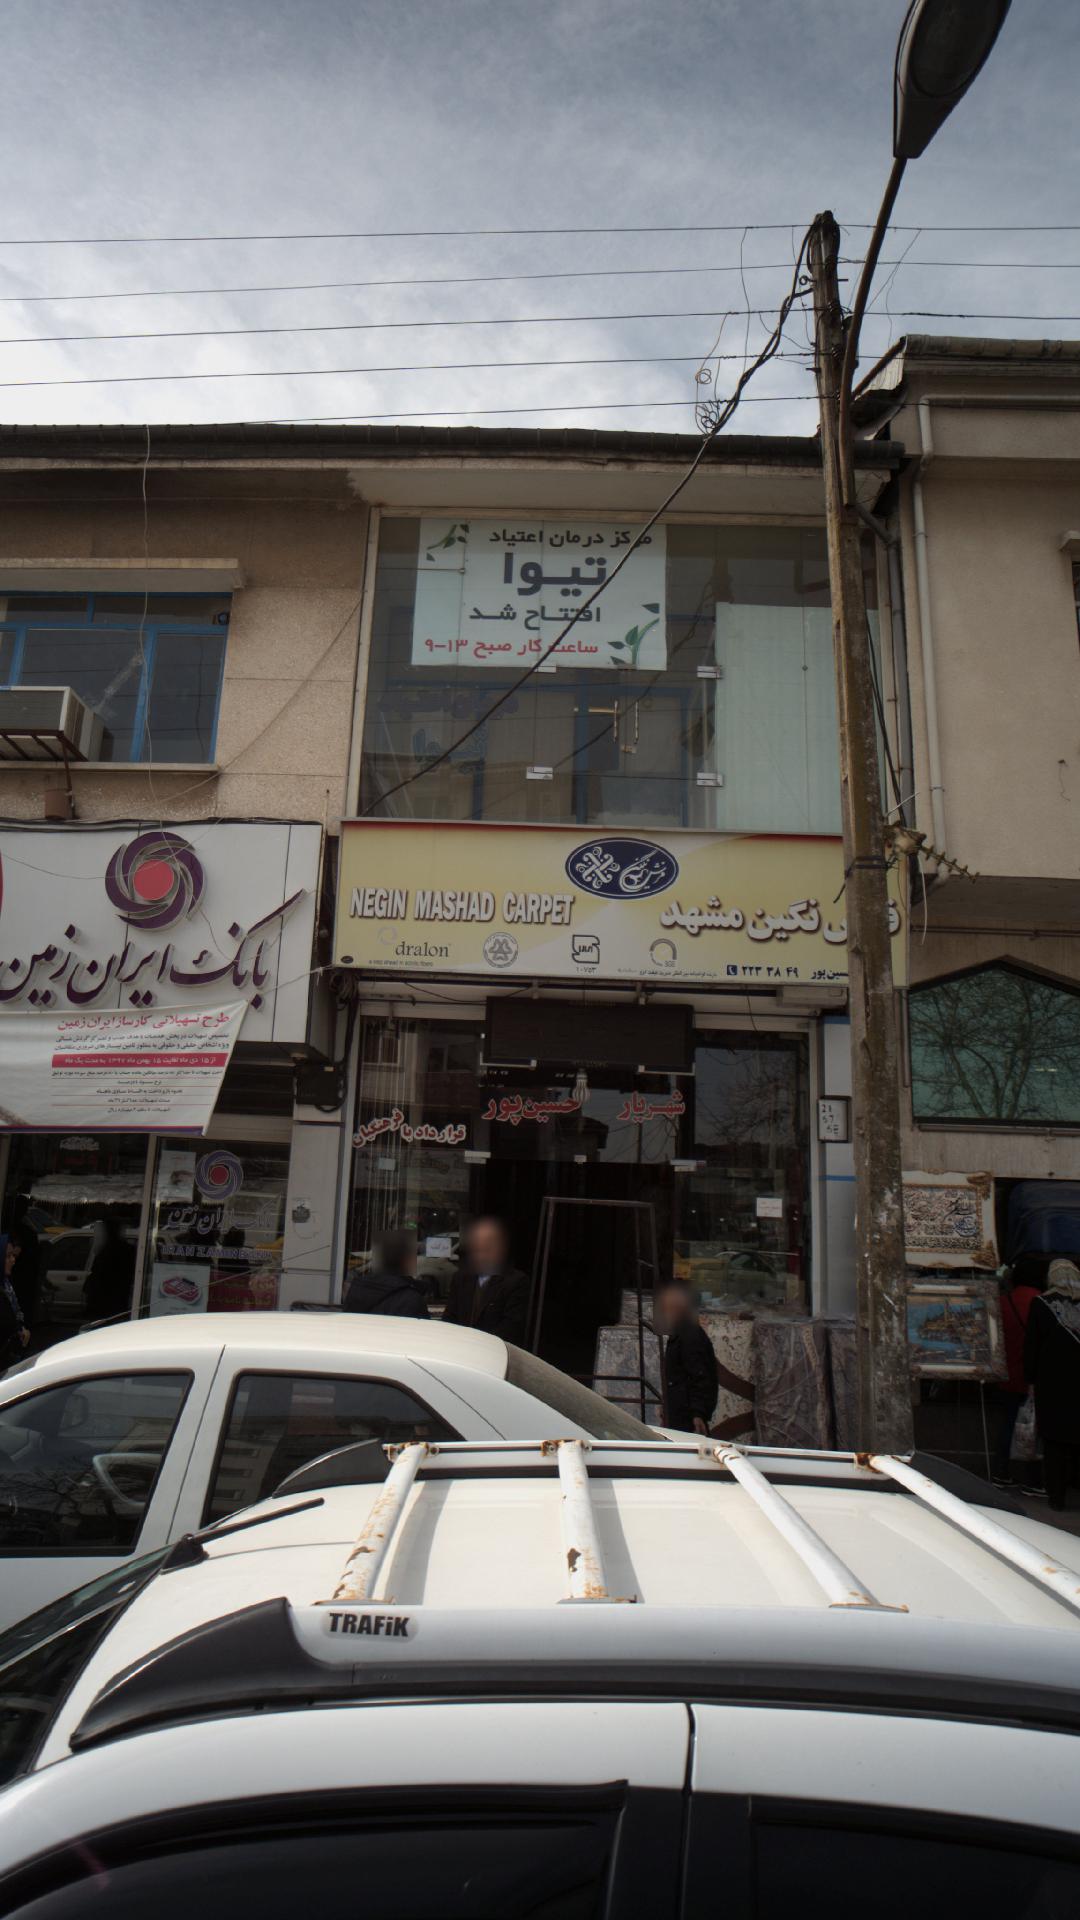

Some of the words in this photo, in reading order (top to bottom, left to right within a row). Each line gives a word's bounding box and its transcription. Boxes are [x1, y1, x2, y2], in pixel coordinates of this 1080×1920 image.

[489, 529, 543, 547] اعتیاد
[549, 530, 604, 548] درمان
[610, 530, 652, 548] مرکز
[503, 552, 607, 597] تیوا
[469, 603, 517, 621] شد
[524, 605, 600, 630] افتتاح
[473, 640, 512, 658] صبح
[518, 639, 543, 656] کار
[550, 640, 599, 654] ساعت
[350, 887, 408, 920] NEGIN
[414, 889, 495, 923] MASHAD
[503, 892, 576, 925] CARPET
[660, 896, 745, 936] مشهد
[747, 899, 820, 941] نگین
[170, 888, 307, 1010] بانک
[395, 941, 449, 958] dralon
[0, 924, 76, 1006] زمین
[67, 941, 174, 1007] ایران
[202, 1012, 230, 1029] طرح
[616, 1090, 686, 1122] شهریار
[352, 1107, 405, 1148] فرهنگیان
[400, 1124, 413, 1142] با
